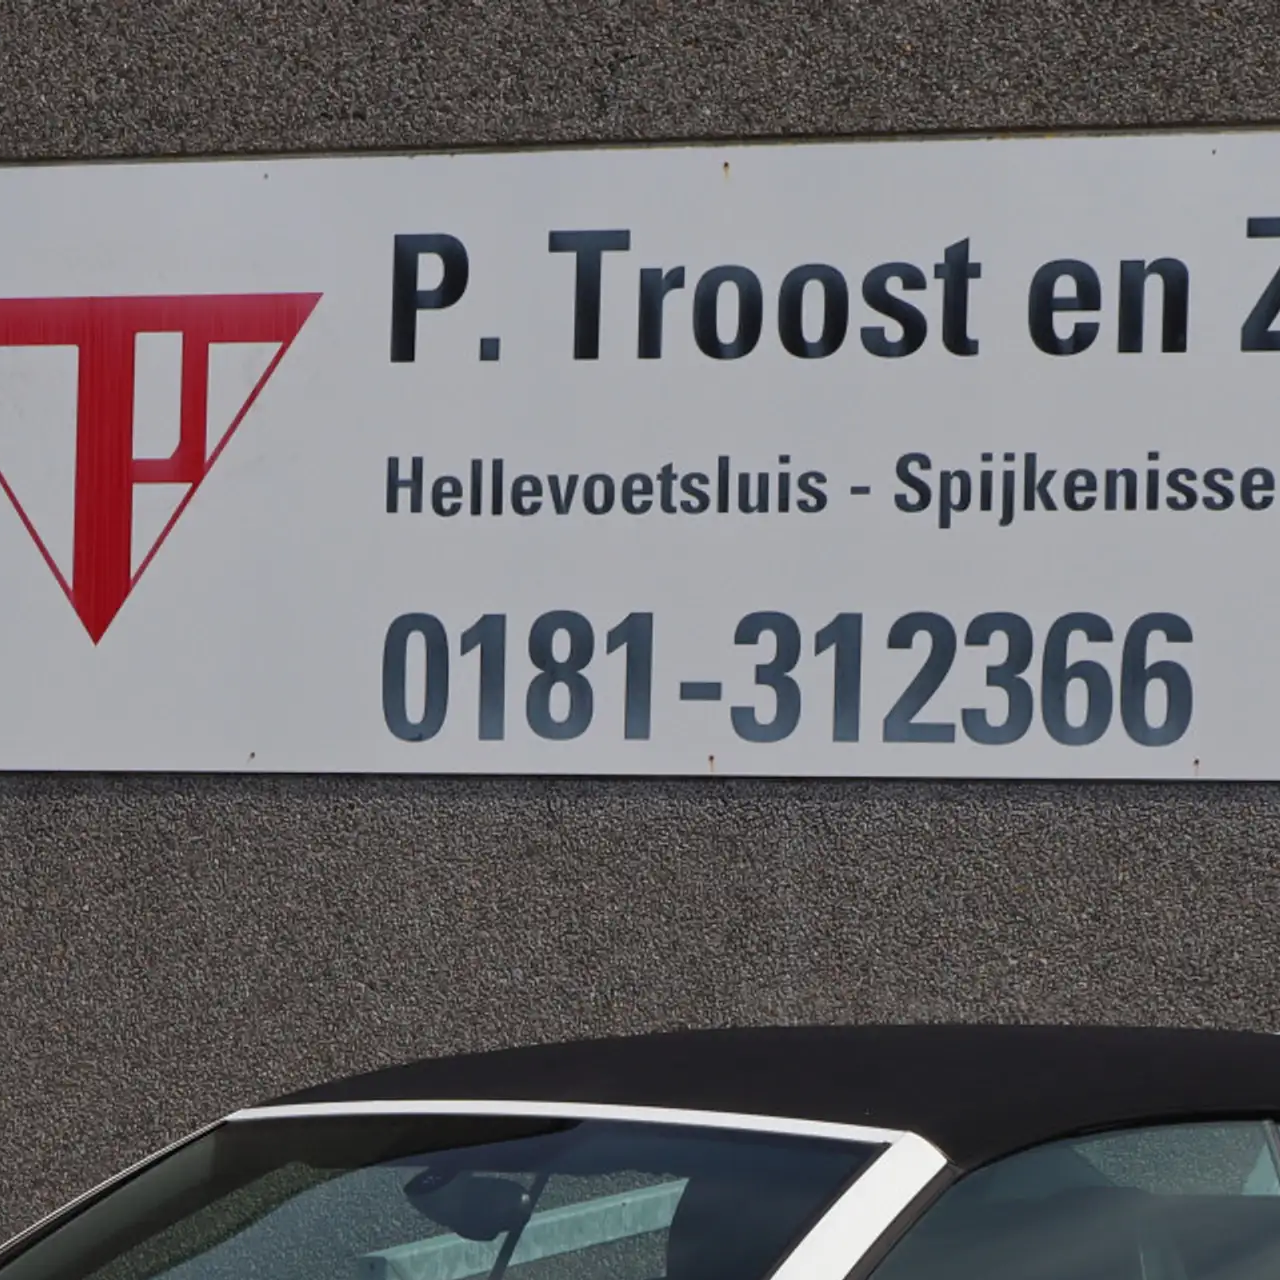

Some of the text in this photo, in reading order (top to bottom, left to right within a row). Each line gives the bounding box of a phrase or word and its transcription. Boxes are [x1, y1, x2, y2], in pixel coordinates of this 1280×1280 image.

[389, 233, 501, 363] P.
[547, 229, 982, 360] Troost
[1027, 257, 1190, 356] en
[385, 454, 828, 518] Hellevoetsluis
[893, 450, 1276, 529] Spijkenisse
[382, 610, 1194, 748] 0181-312366
